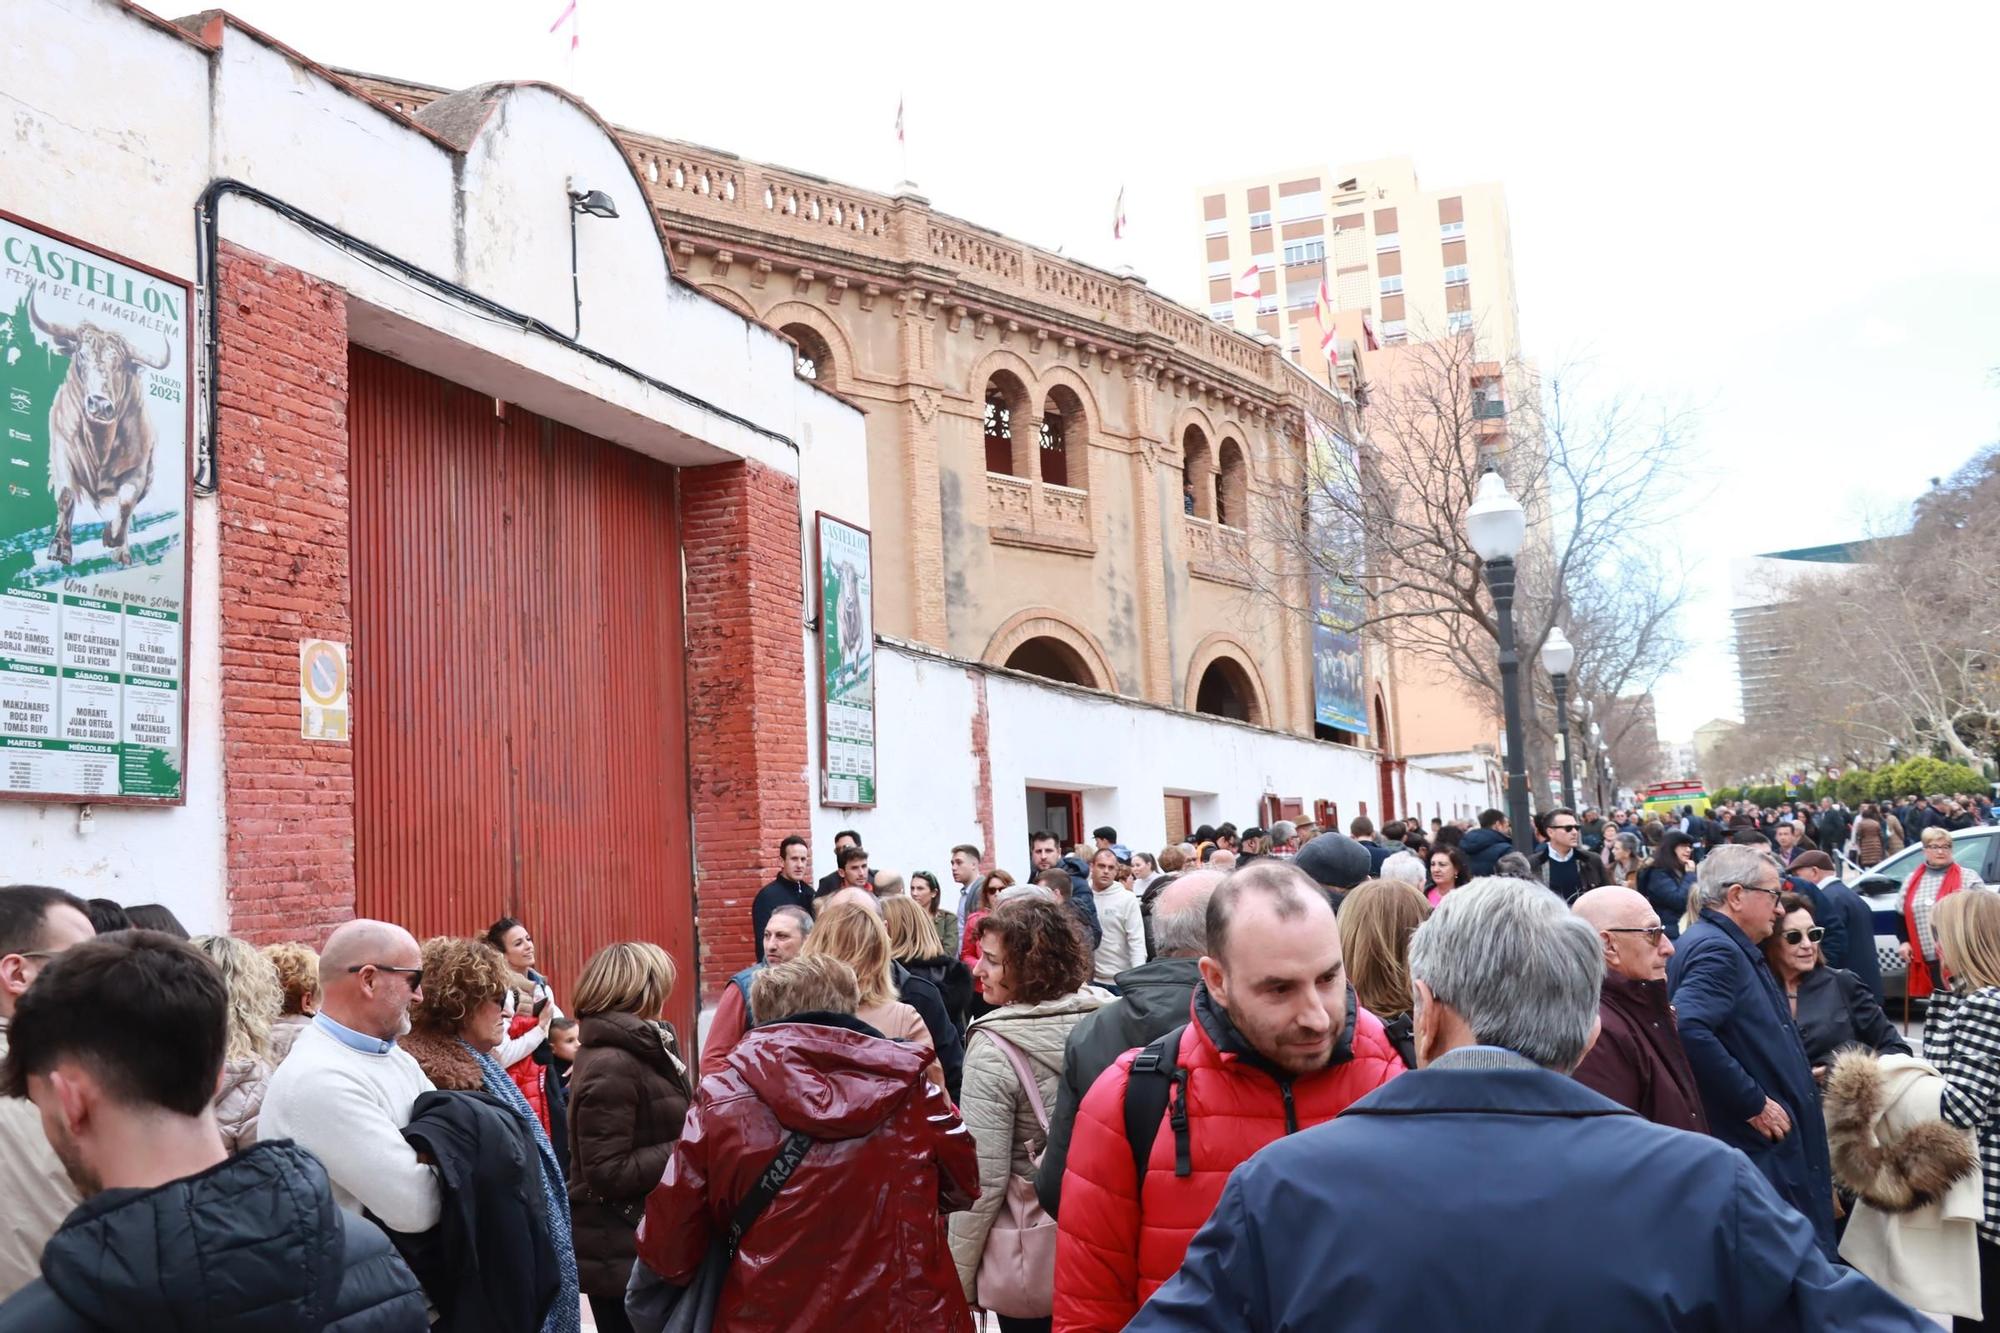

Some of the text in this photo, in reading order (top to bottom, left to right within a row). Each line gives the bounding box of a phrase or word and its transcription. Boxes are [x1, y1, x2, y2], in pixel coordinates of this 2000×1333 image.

[4, 236, 179, 321] CASTELLÓN
[5, 267, 179, 339] FERIA DE LA MAGDALENA
[150, 372, 181, 389] MARZO
[150, 383, 181, 404] 2024
[63, 577, 88, 595] Una
[7, 587, 42, 600] DOMINGO
[79, 599, 101, 609] LUNES
[137, 608, 161, 619] JUEVES
[4, 630, 50, 645] PACO RAMOS
[63, 631, 120, 647] ANDY CARTAGENA
[66, 642, 117, 657] DIEGO VENTURA
[73, 654, 111, 667] LEA VICENS
[126, 651, 156, 664] FERNANDO
[8, 663, 39, 673] VIERNES
[74, 670, 104, 682] SÁBADO
[132, 678, 162, 688] DOMINGO
[2, 699, 51, 713] MANZANARES
[9, 711, 43, 723] ROCA REY
[76, 707, 108, 719] MORANTE
[136, 713, 165, 724] CASTELLA
[30, 724, 49, 735] RUFO
[69, 717, 113, 730] JUAN ORTEGA
[130, 723, 172, 735] MANZANARES
[66, 727, 115, 741] PABLO AGUADO
[7, 739, 37, 749] MARTES
